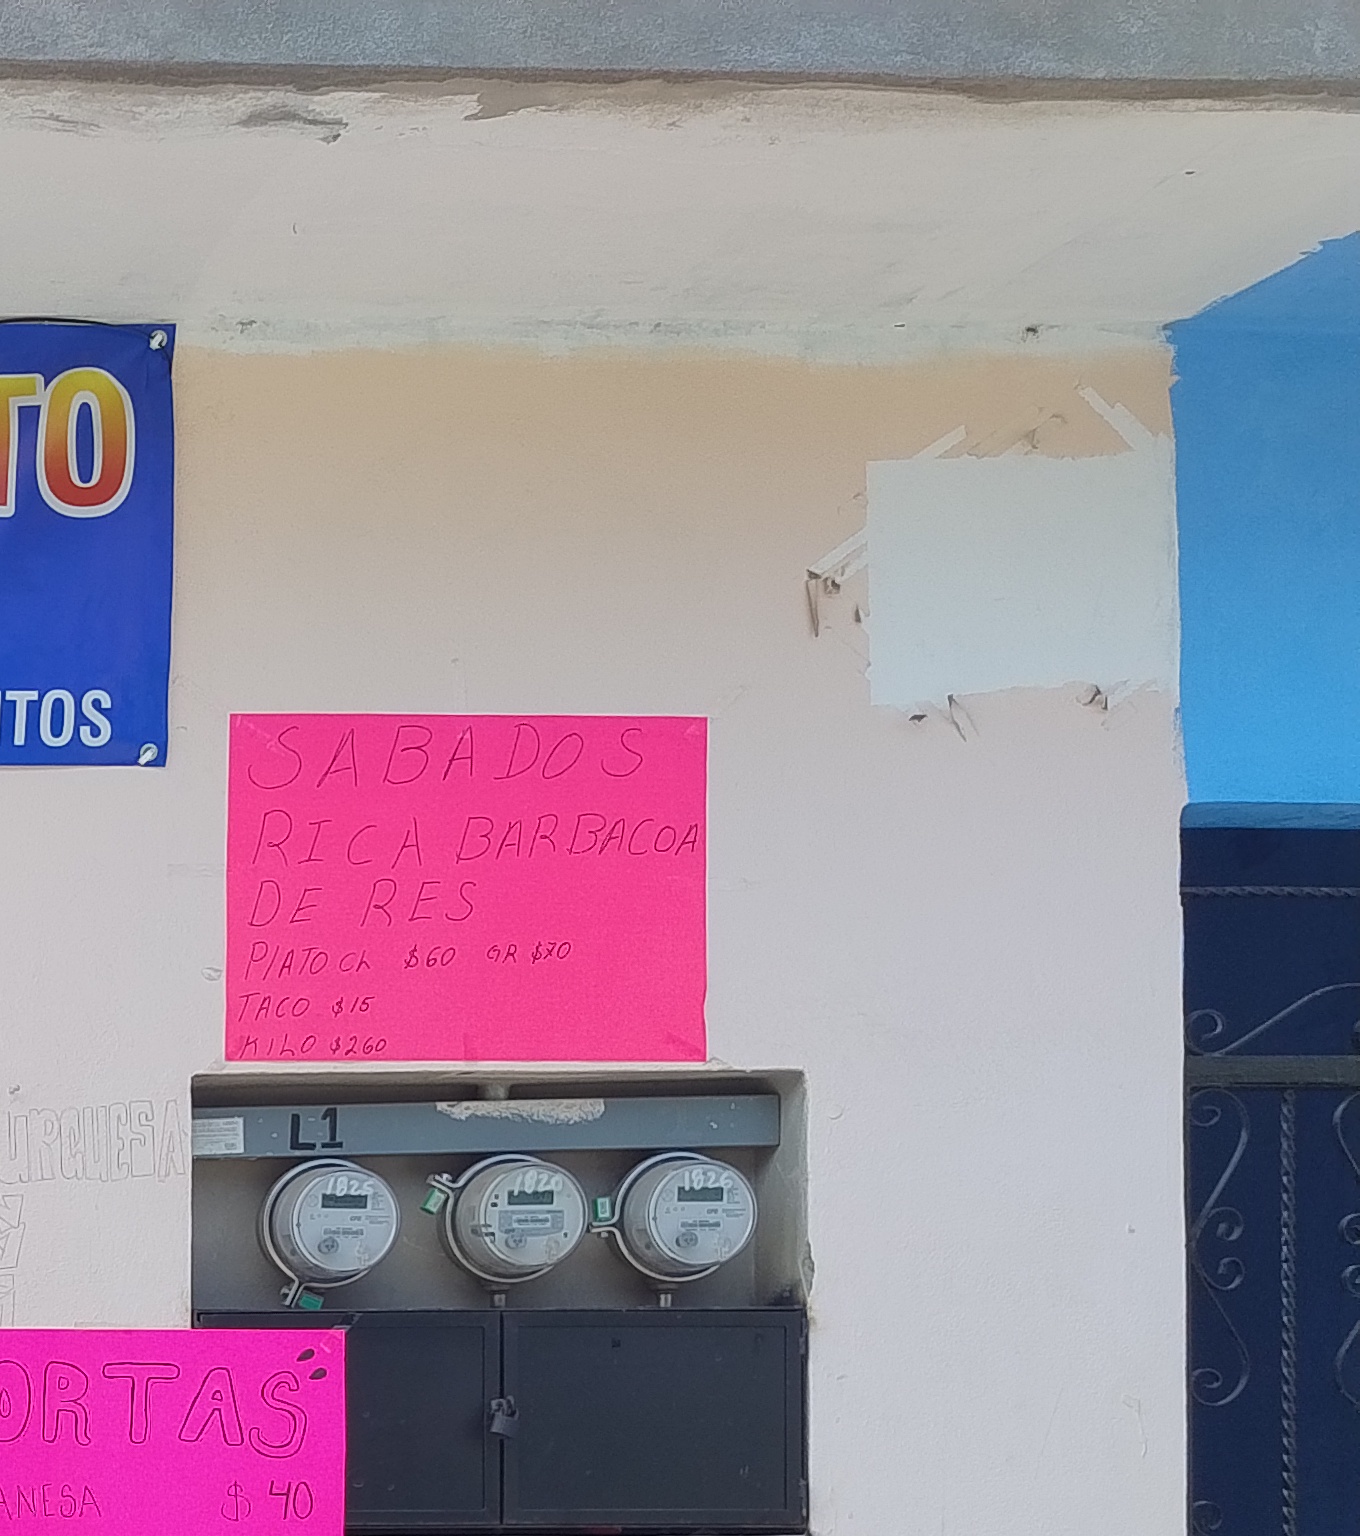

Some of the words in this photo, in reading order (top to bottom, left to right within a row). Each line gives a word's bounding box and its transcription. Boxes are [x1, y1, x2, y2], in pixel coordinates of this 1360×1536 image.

[247, 722, 644, 790] SABADOS
[251, 809, 423, 870] RICA
[455, 813, 700, 866] BARBACOA
[247, 879, 323, 927] DE
[360, 878, 477, 928] RES
[404, 945, 456, 969] $60
[531, 941, 572, 964] $70
[238, 992, 310, 1022] TACO
[331, 995, 375, 1018] $15
[239, 1034, 316, 1059] KILO
[330, 1036, 387, 1055] $260
[289, 1107, 344, 1151] L1
